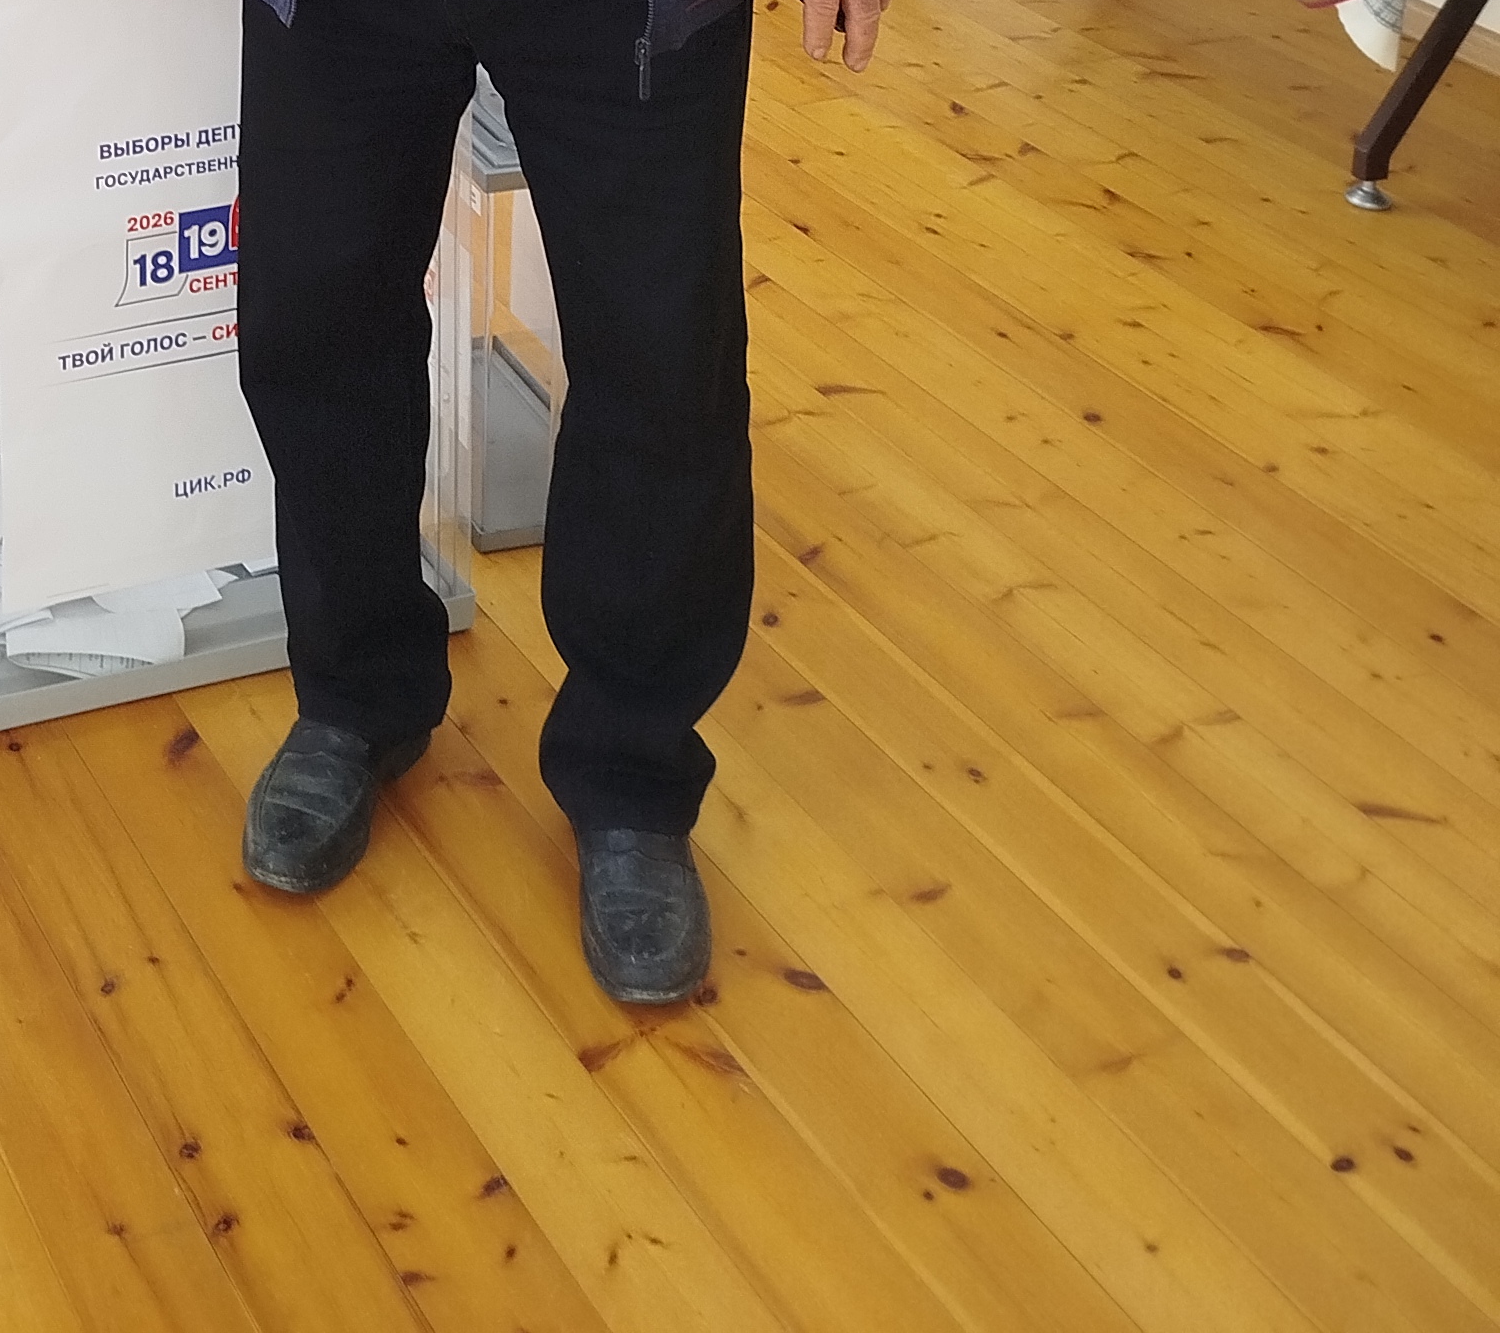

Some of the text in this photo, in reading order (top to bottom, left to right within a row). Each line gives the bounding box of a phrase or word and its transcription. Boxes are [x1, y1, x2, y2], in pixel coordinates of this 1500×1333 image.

[99, 124, 240, 160] ВЫБОРЫ ДЕП
[127, 210, 175, 233] 2026
[183, 220, 227, 260] 19
[132, 249, 175, 287] 18
[57, 342, 115, 371] ТВОЙ
[119, 332, 188, 359] ГОЛОС
[174, 467, 252, 499] ЦИК.РФ
